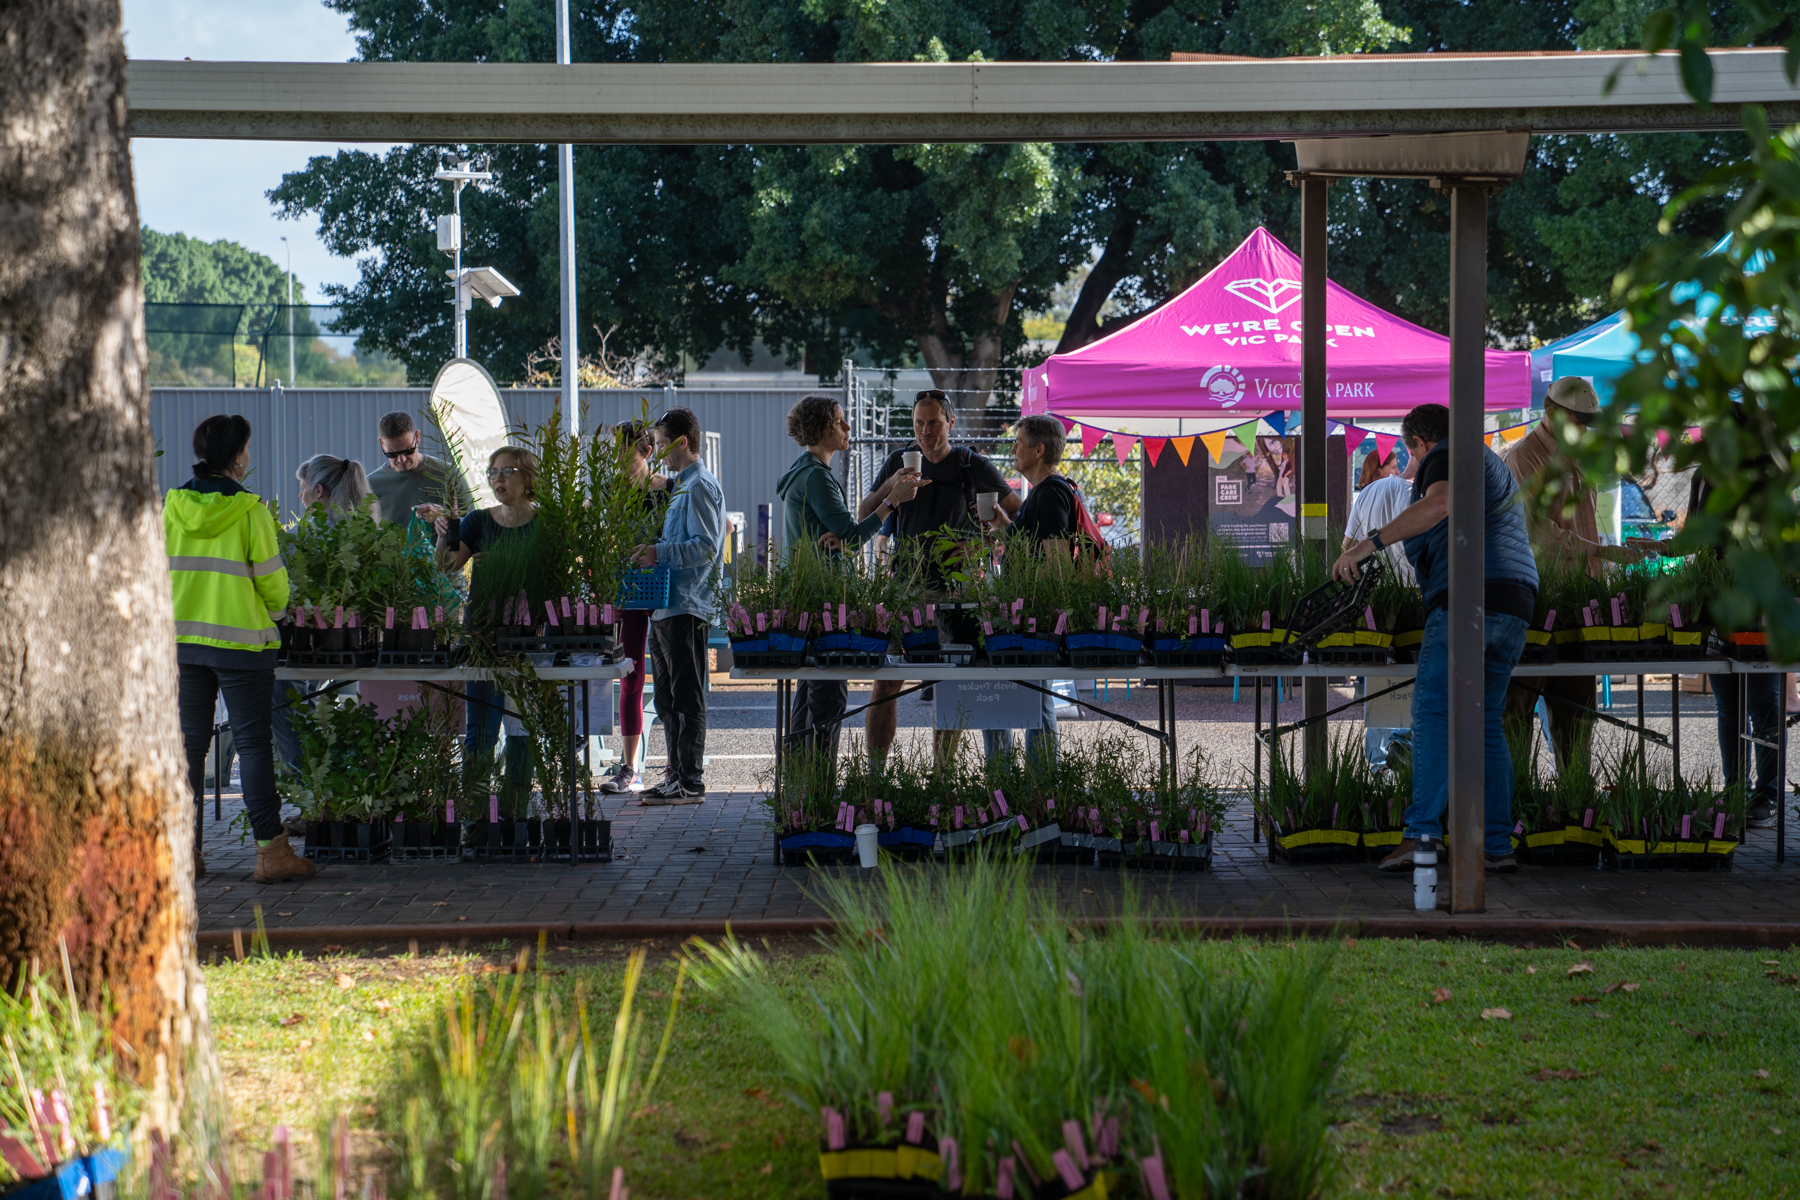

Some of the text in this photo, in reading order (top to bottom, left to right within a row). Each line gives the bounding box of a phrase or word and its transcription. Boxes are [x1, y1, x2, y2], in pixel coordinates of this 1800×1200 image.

[1180, 319, 1281, 336] WE'RE
[1222, 334, 1338, 347] VIC PAK
[1254, 378, 1375, 398] VICTO PARK
[1509, 410, 1545, 420] WST
[470, 446, 495, 459] Urb
